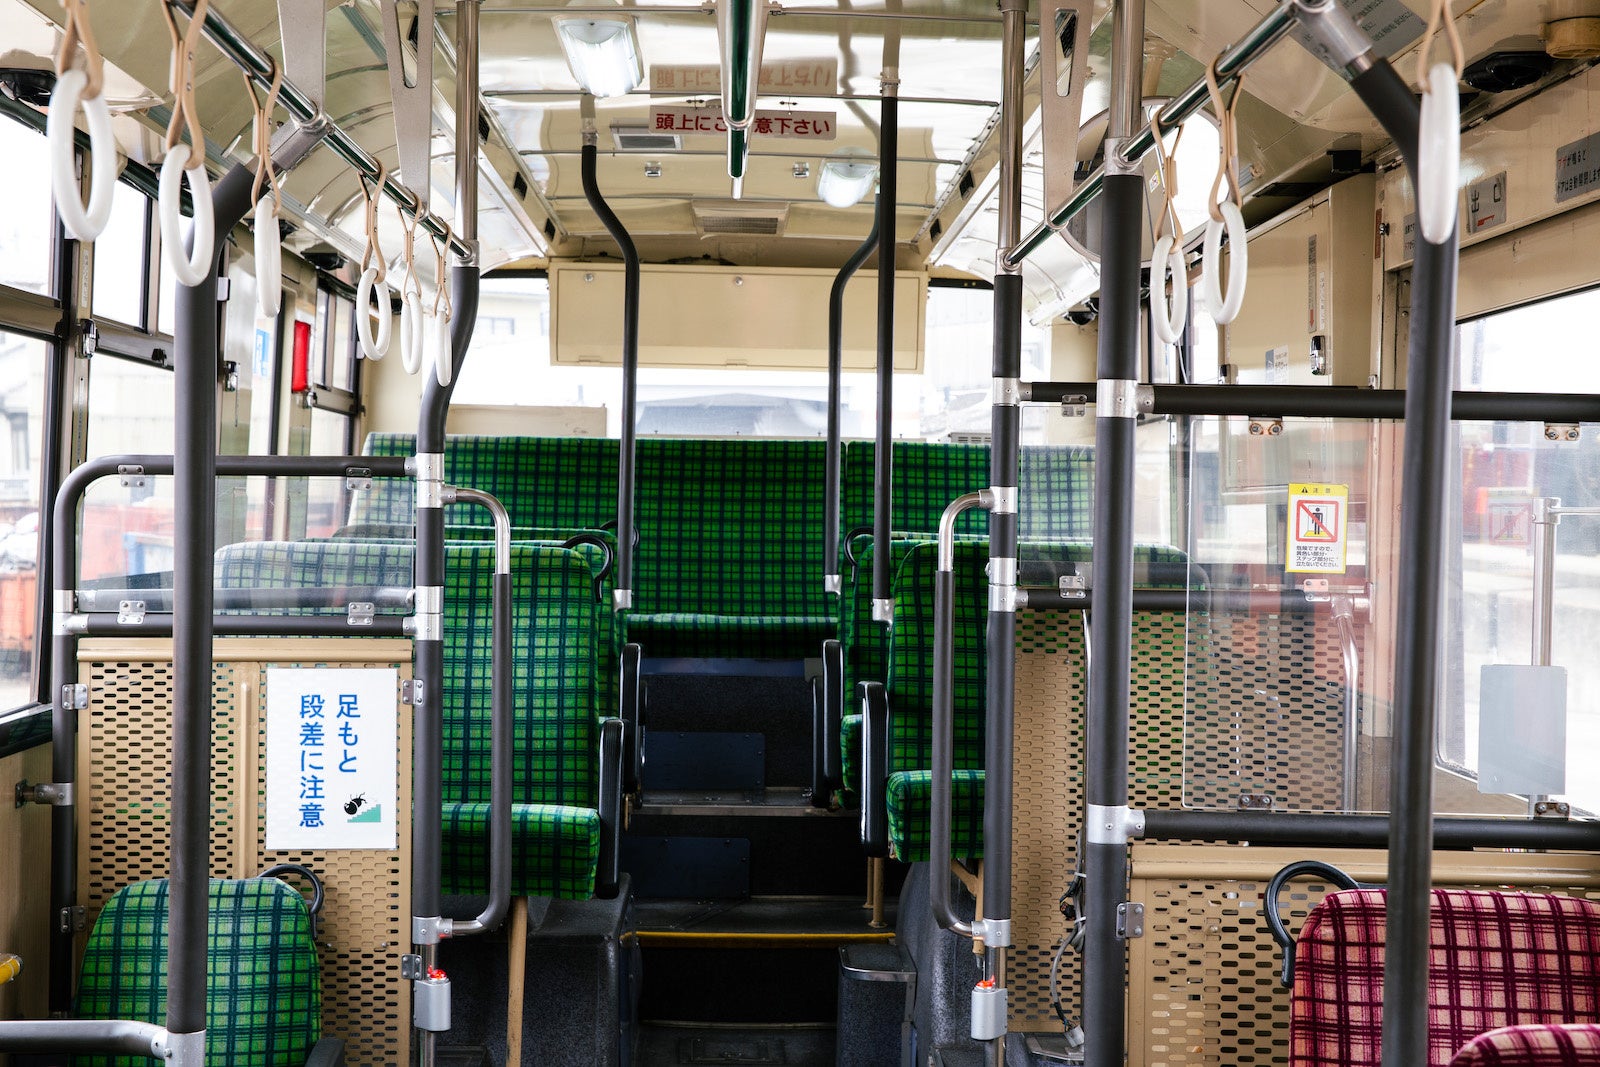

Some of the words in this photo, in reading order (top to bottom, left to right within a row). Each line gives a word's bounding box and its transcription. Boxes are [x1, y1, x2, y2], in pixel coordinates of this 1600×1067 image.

[299, 694, 326, 828] 段差に注意
[336, 694, 361, 773] 足もと
